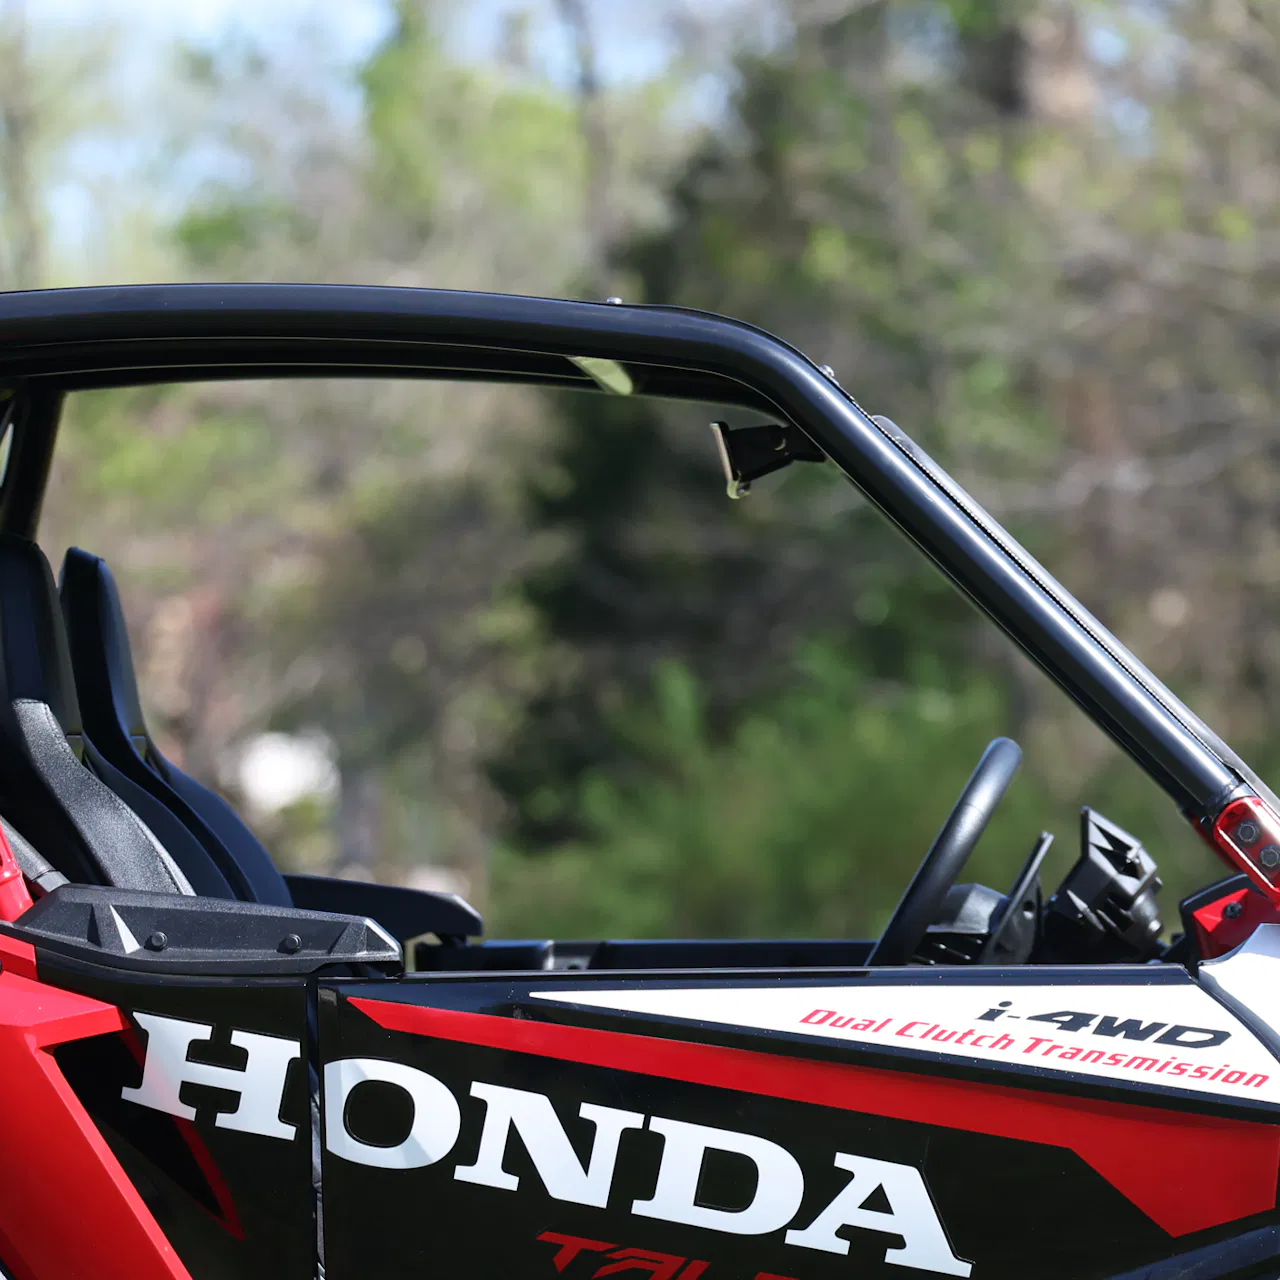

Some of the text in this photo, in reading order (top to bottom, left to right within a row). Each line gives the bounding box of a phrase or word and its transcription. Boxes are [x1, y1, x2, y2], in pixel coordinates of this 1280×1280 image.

[800, 1008, 1270, 1089] Dual Clutch Transmission
[976, 1001, 1231, 1049] i-4WD
[121, 1010, 976, 1279] HONDA
